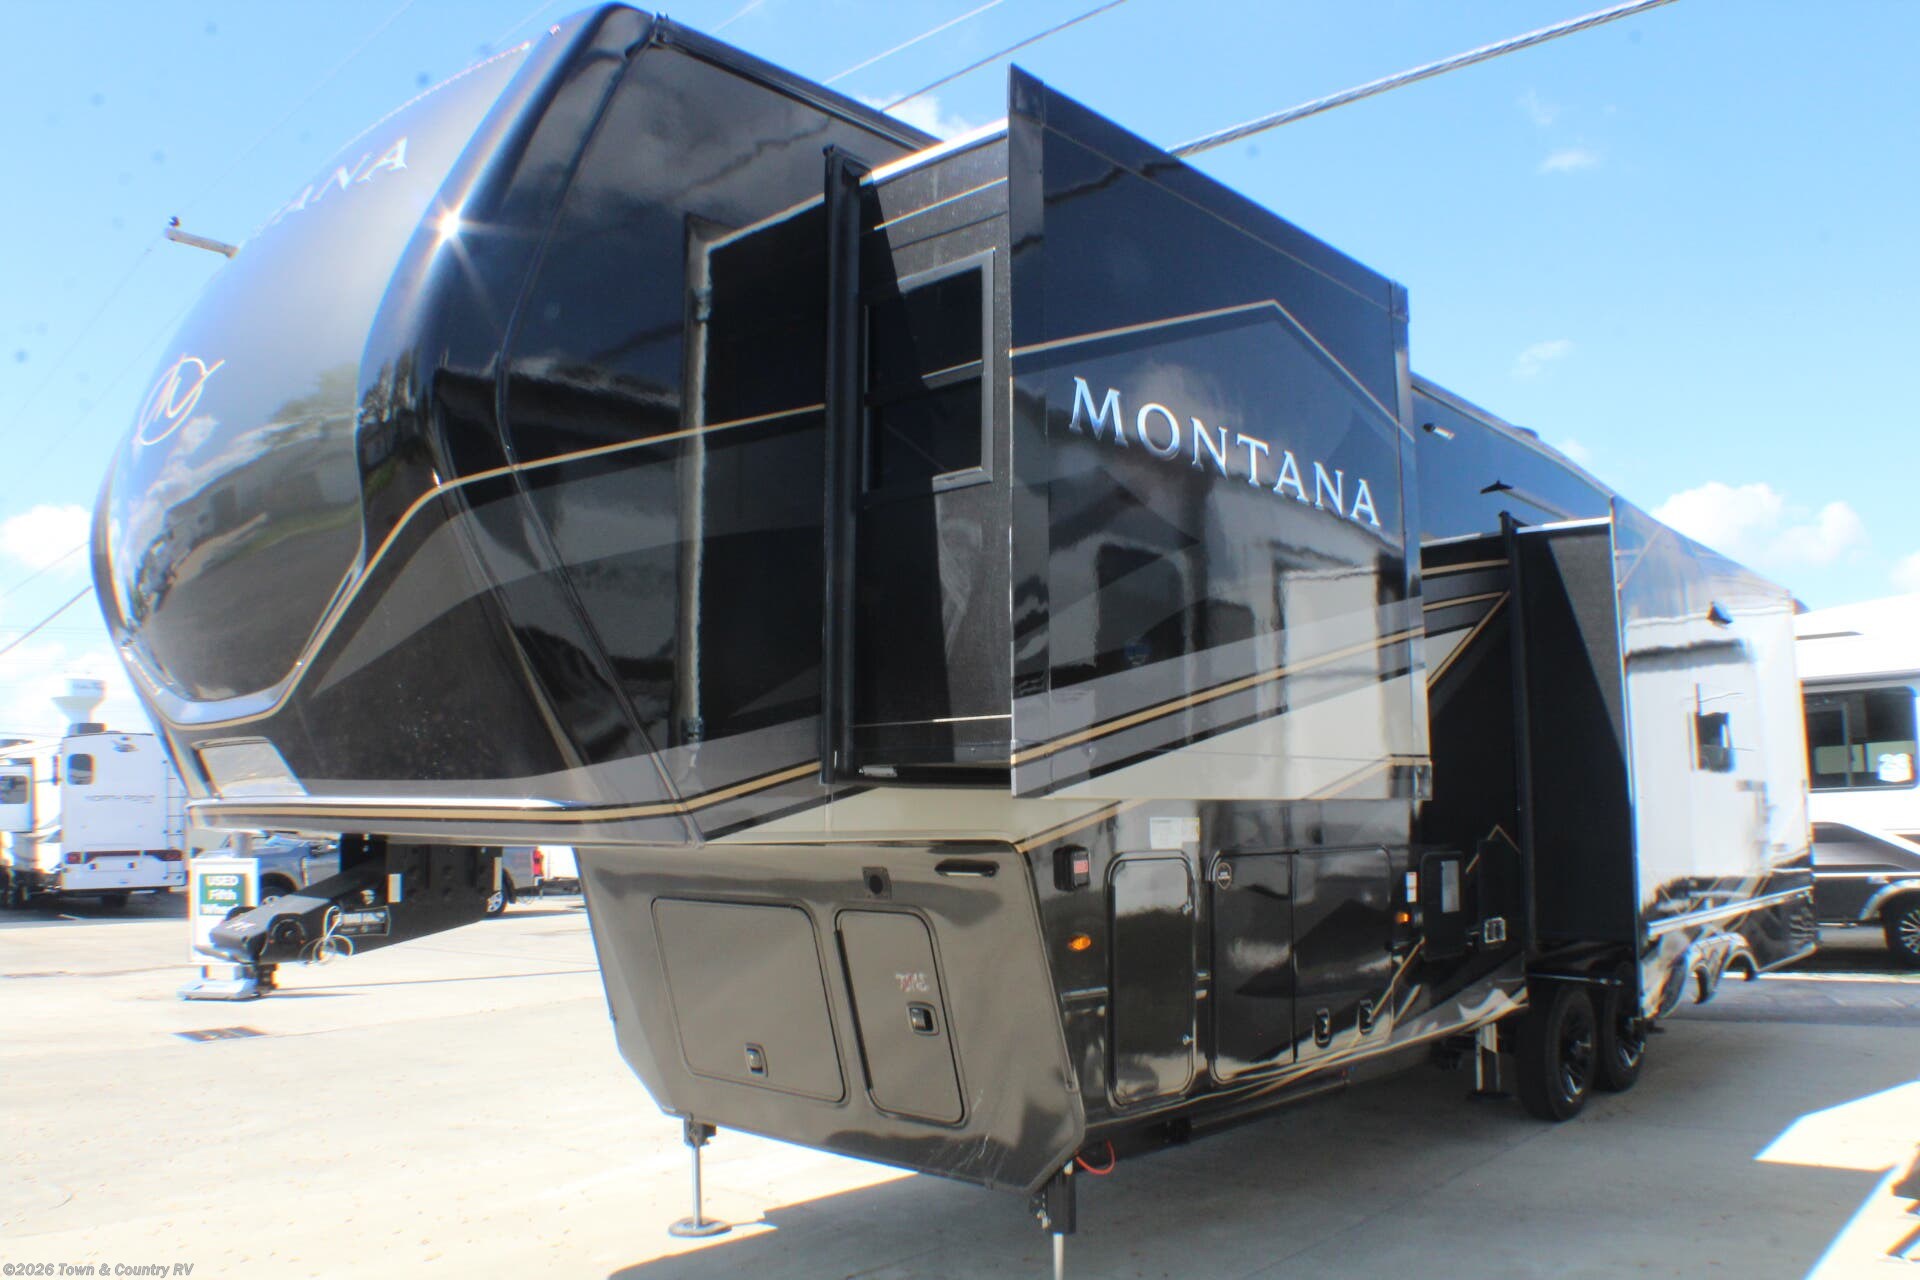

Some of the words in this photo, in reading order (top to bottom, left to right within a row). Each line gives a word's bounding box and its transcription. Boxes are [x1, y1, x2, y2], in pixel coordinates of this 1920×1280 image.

[1069, 376, 1381, 527] MONTANA
[206, 875, 238, 886] USED
[208, 889, 236, 901] Fifth
